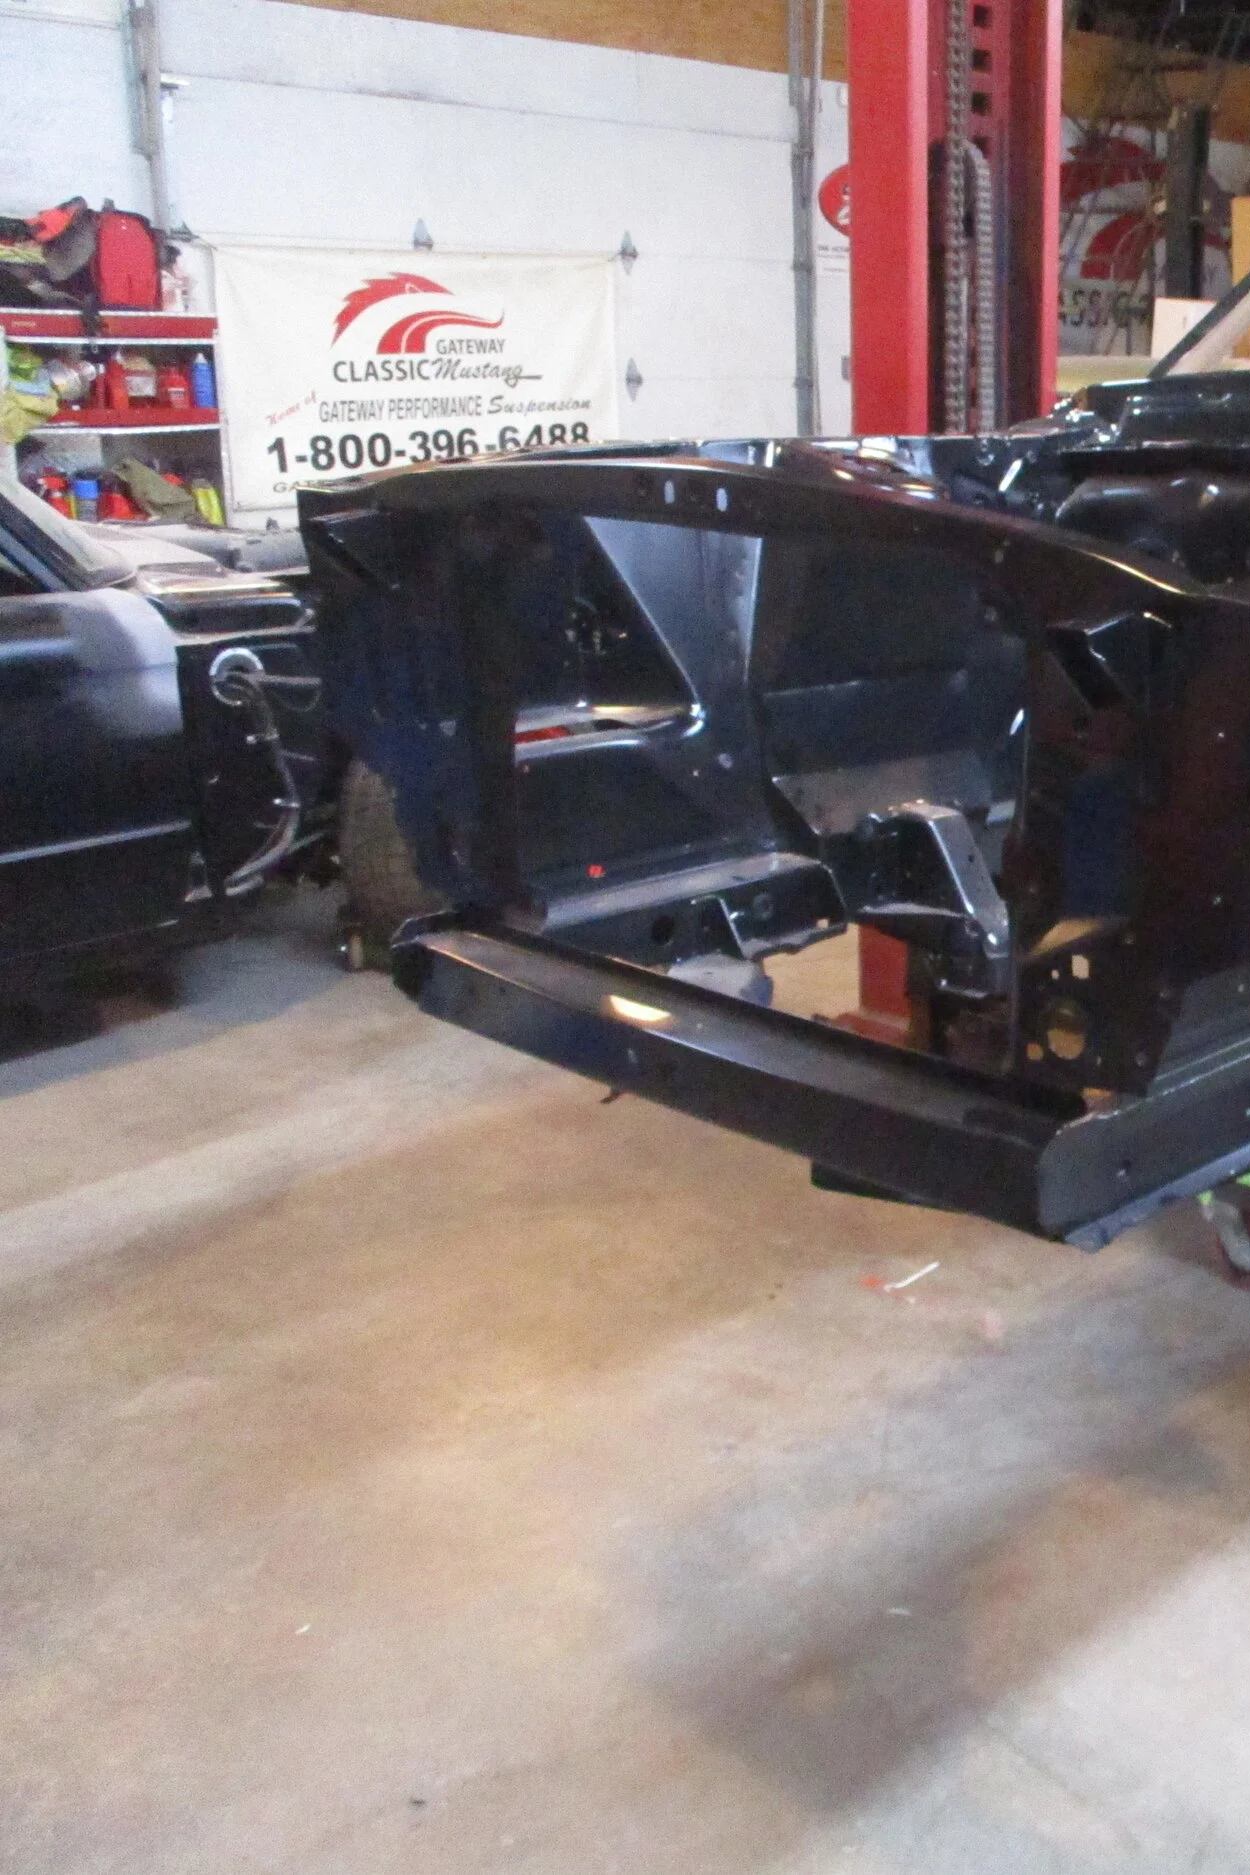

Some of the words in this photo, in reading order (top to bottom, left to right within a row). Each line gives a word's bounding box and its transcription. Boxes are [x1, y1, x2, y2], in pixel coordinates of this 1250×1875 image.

[436, 338, 506, 356] GATEWAY
[332, 358, 431, 383] CLASSIC
[430, 357, 543, 389] Mustang
[318, 399, 385, 423] GATEWAY
[387, 395, 483, 420] PERFORMANCE
[487, 394, 593, 417] Suspension
[266, 420, 590, 474] 1-800-396-6488
